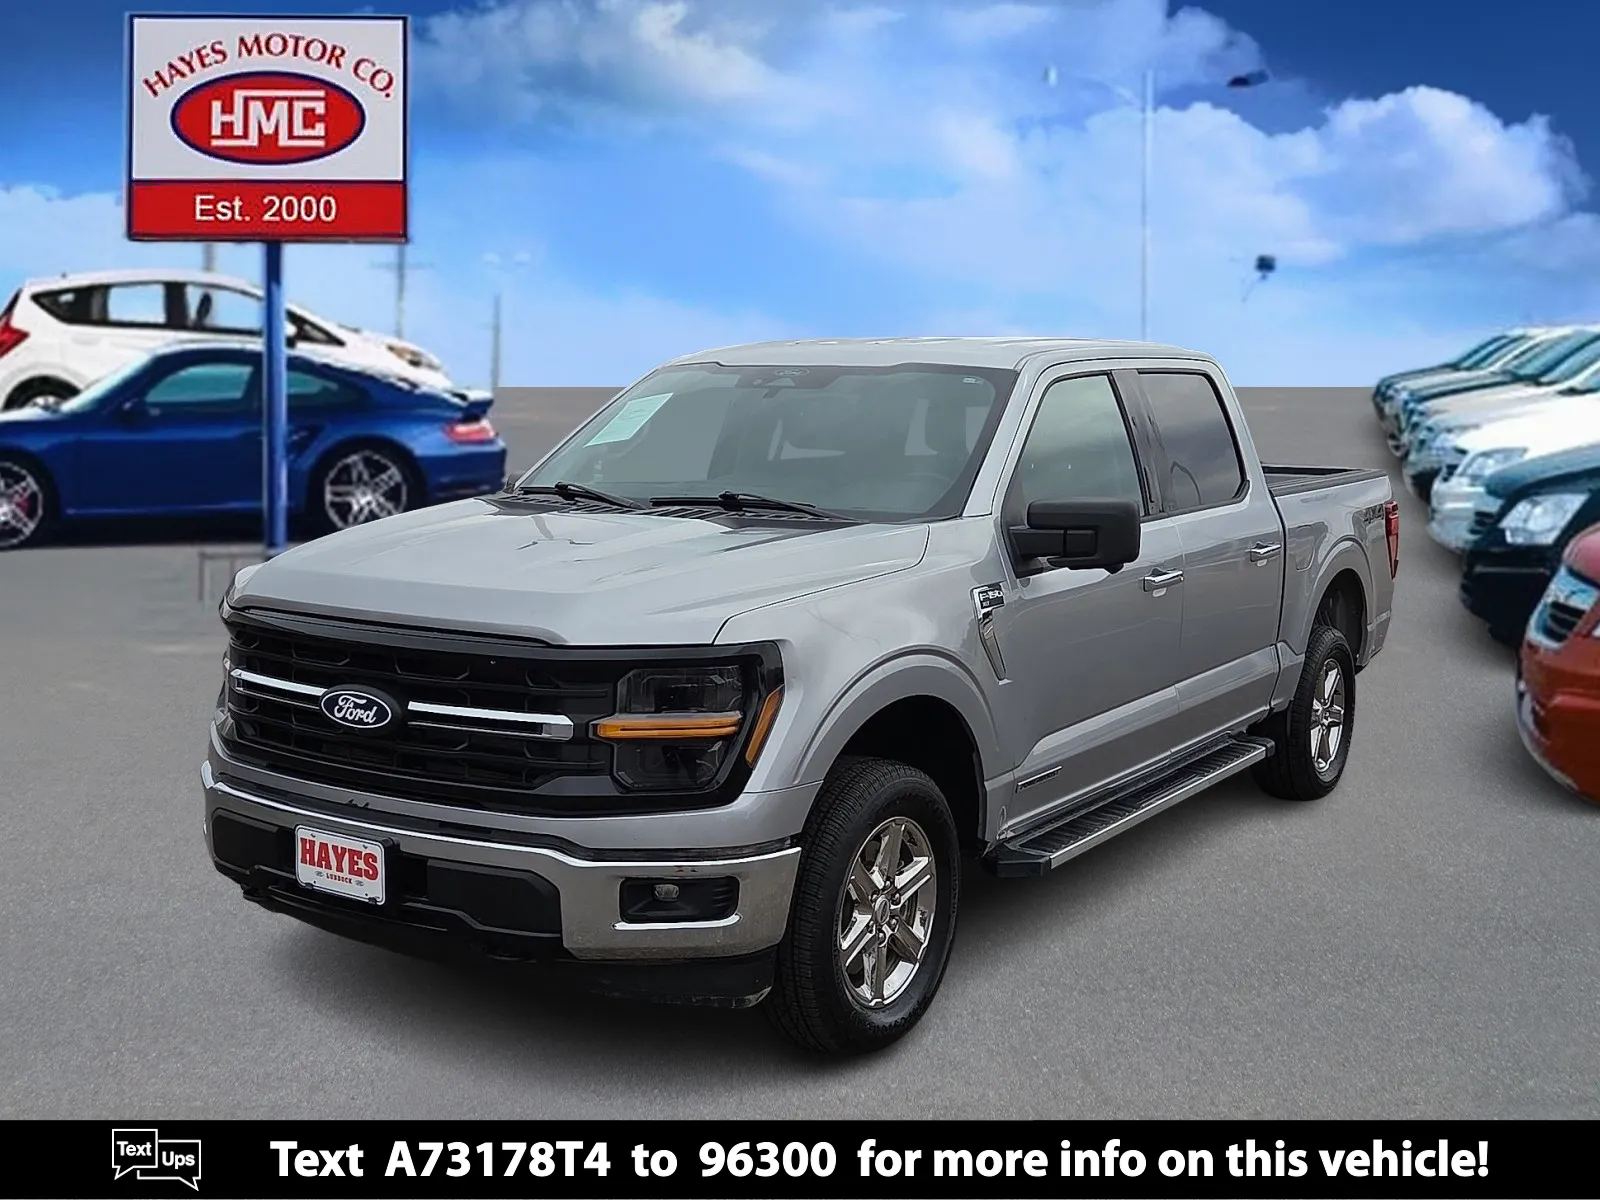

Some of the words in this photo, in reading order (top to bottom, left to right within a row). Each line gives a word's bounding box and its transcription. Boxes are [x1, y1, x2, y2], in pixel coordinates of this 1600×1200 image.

[143, 40, 227, 97] HAYES
[238, 33, 346, 70] MOTOR
[353, 57, 394, 99] CO.
[211, 89, 325, 147] HMC
[195, 195, 250, 222] Est.
[262, 195, 337, 223] 2000
[334, 695, 378, 723] Ford
[300, 837, 379, 880] HAYES
